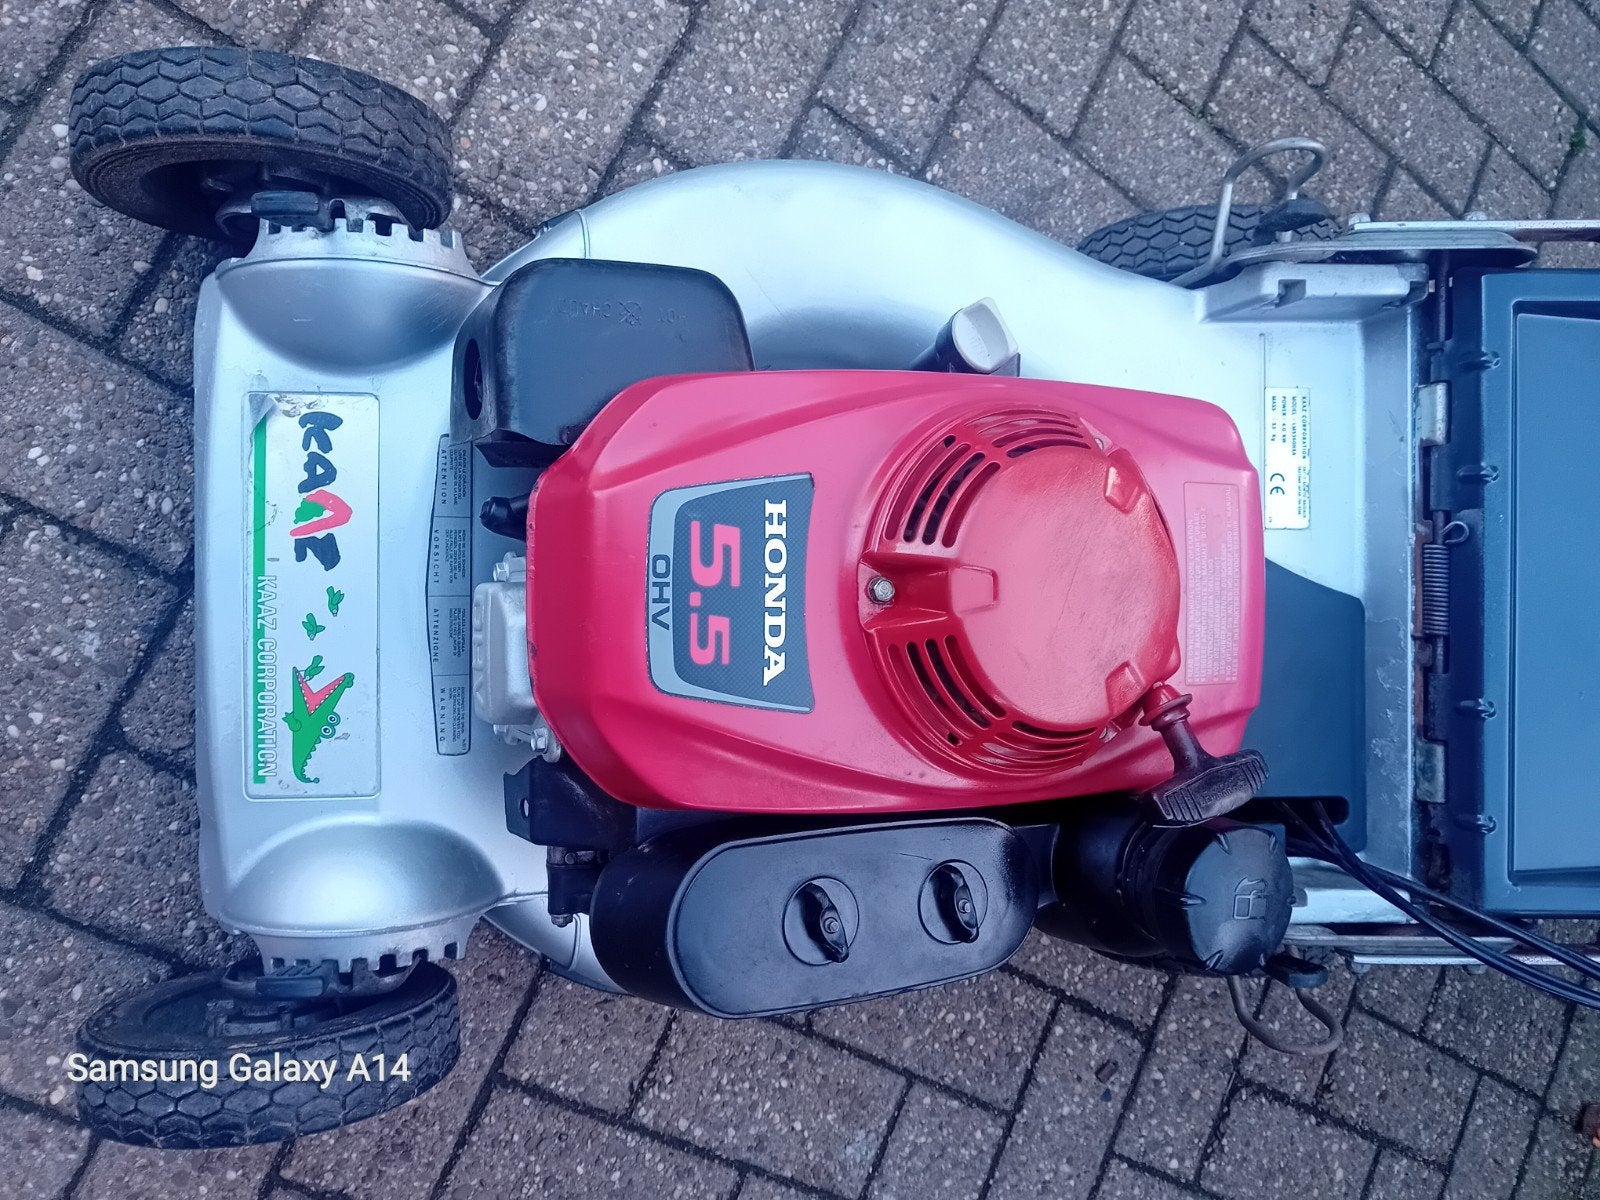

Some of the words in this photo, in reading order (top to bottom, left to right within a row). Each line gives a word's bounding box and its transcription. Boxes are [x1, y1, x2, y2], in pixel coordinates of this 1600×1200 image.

[290, 412, 353, 571] KAAZ
[256, 576, 277, 630] KAAZ
[651, 554, 671, 631] OHV
[689, 520, 741, 666] 5.5
[763, 499, 788, 686] HONDA
[256, 638, 277, 777] CORPORATION
